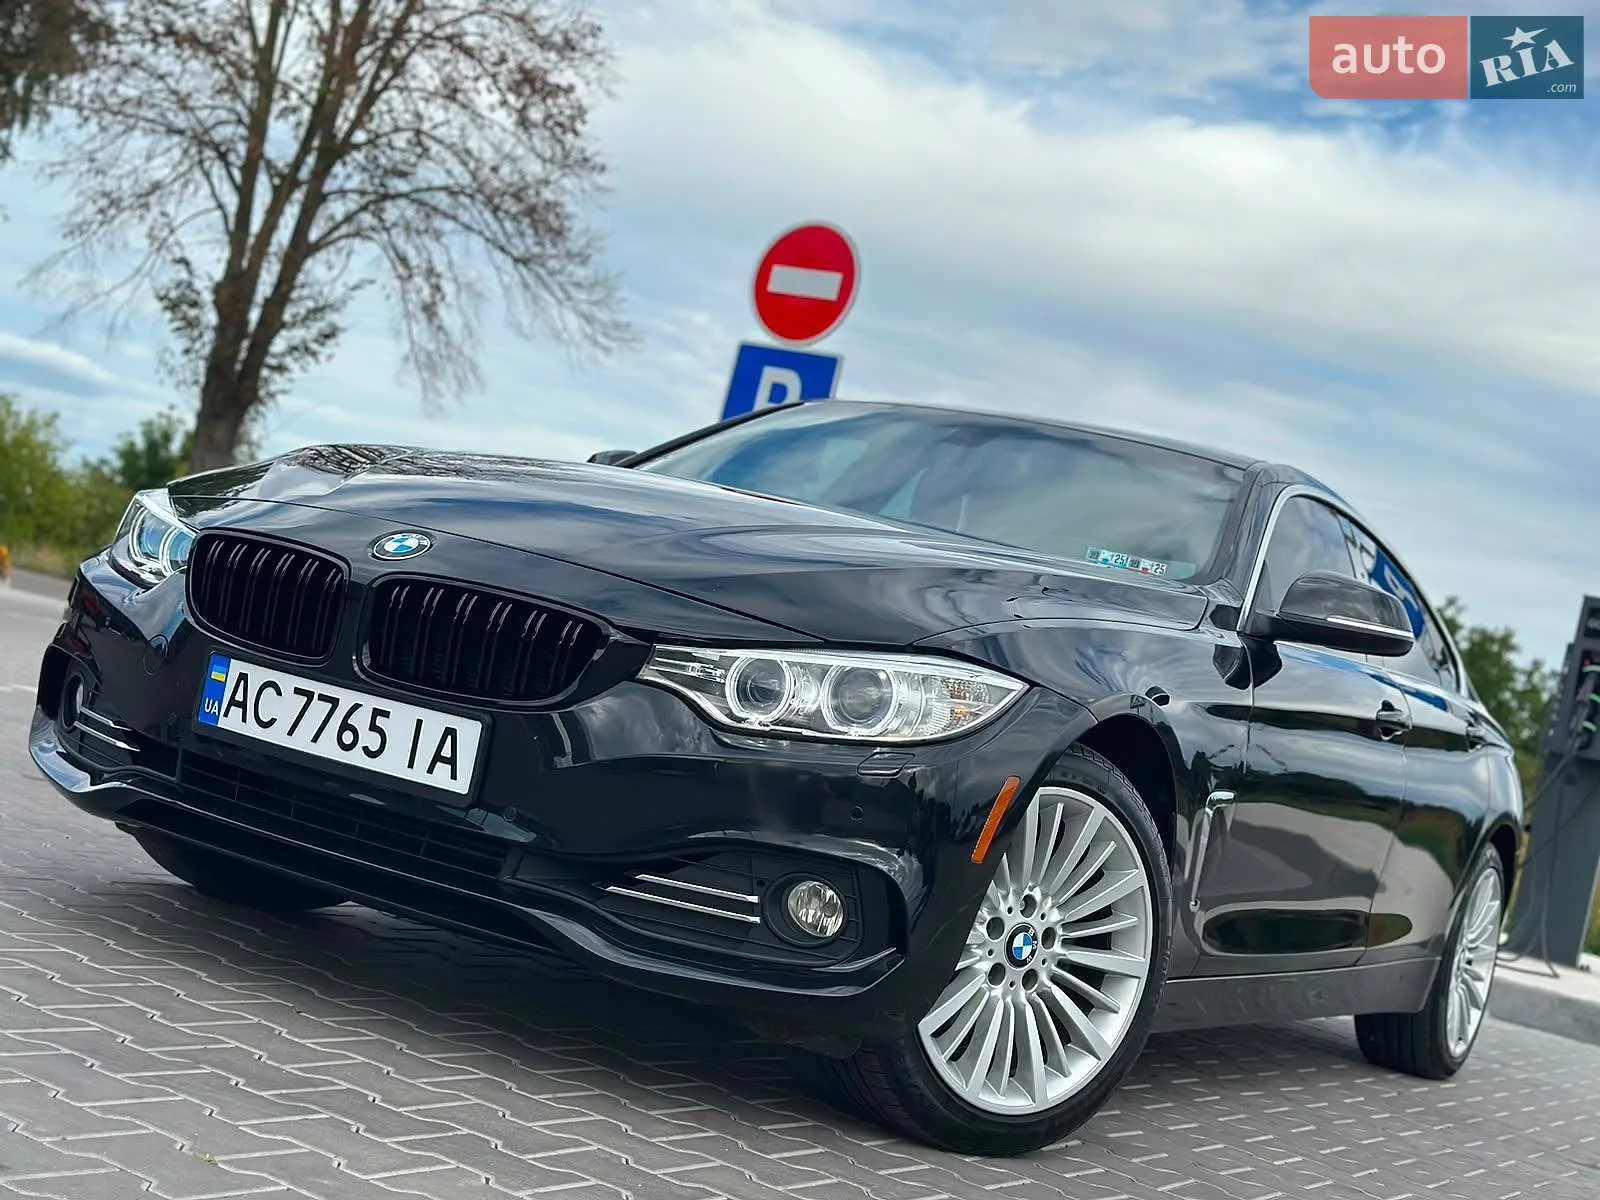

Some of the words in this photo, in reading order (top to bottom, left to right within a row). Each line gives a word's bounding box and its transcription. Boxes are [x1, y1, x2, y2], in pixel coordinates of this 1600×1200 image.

[752, 365, 802, 411] P
[1114, 554, 1125, 565] 25
[1153, 563, 1165, 575] 25
[204, 699, 219, 716] UA
[223, 672, 283, 729] AC
[286, 687, 391, 759] 7765
[407, 718, 457, 781] IA
